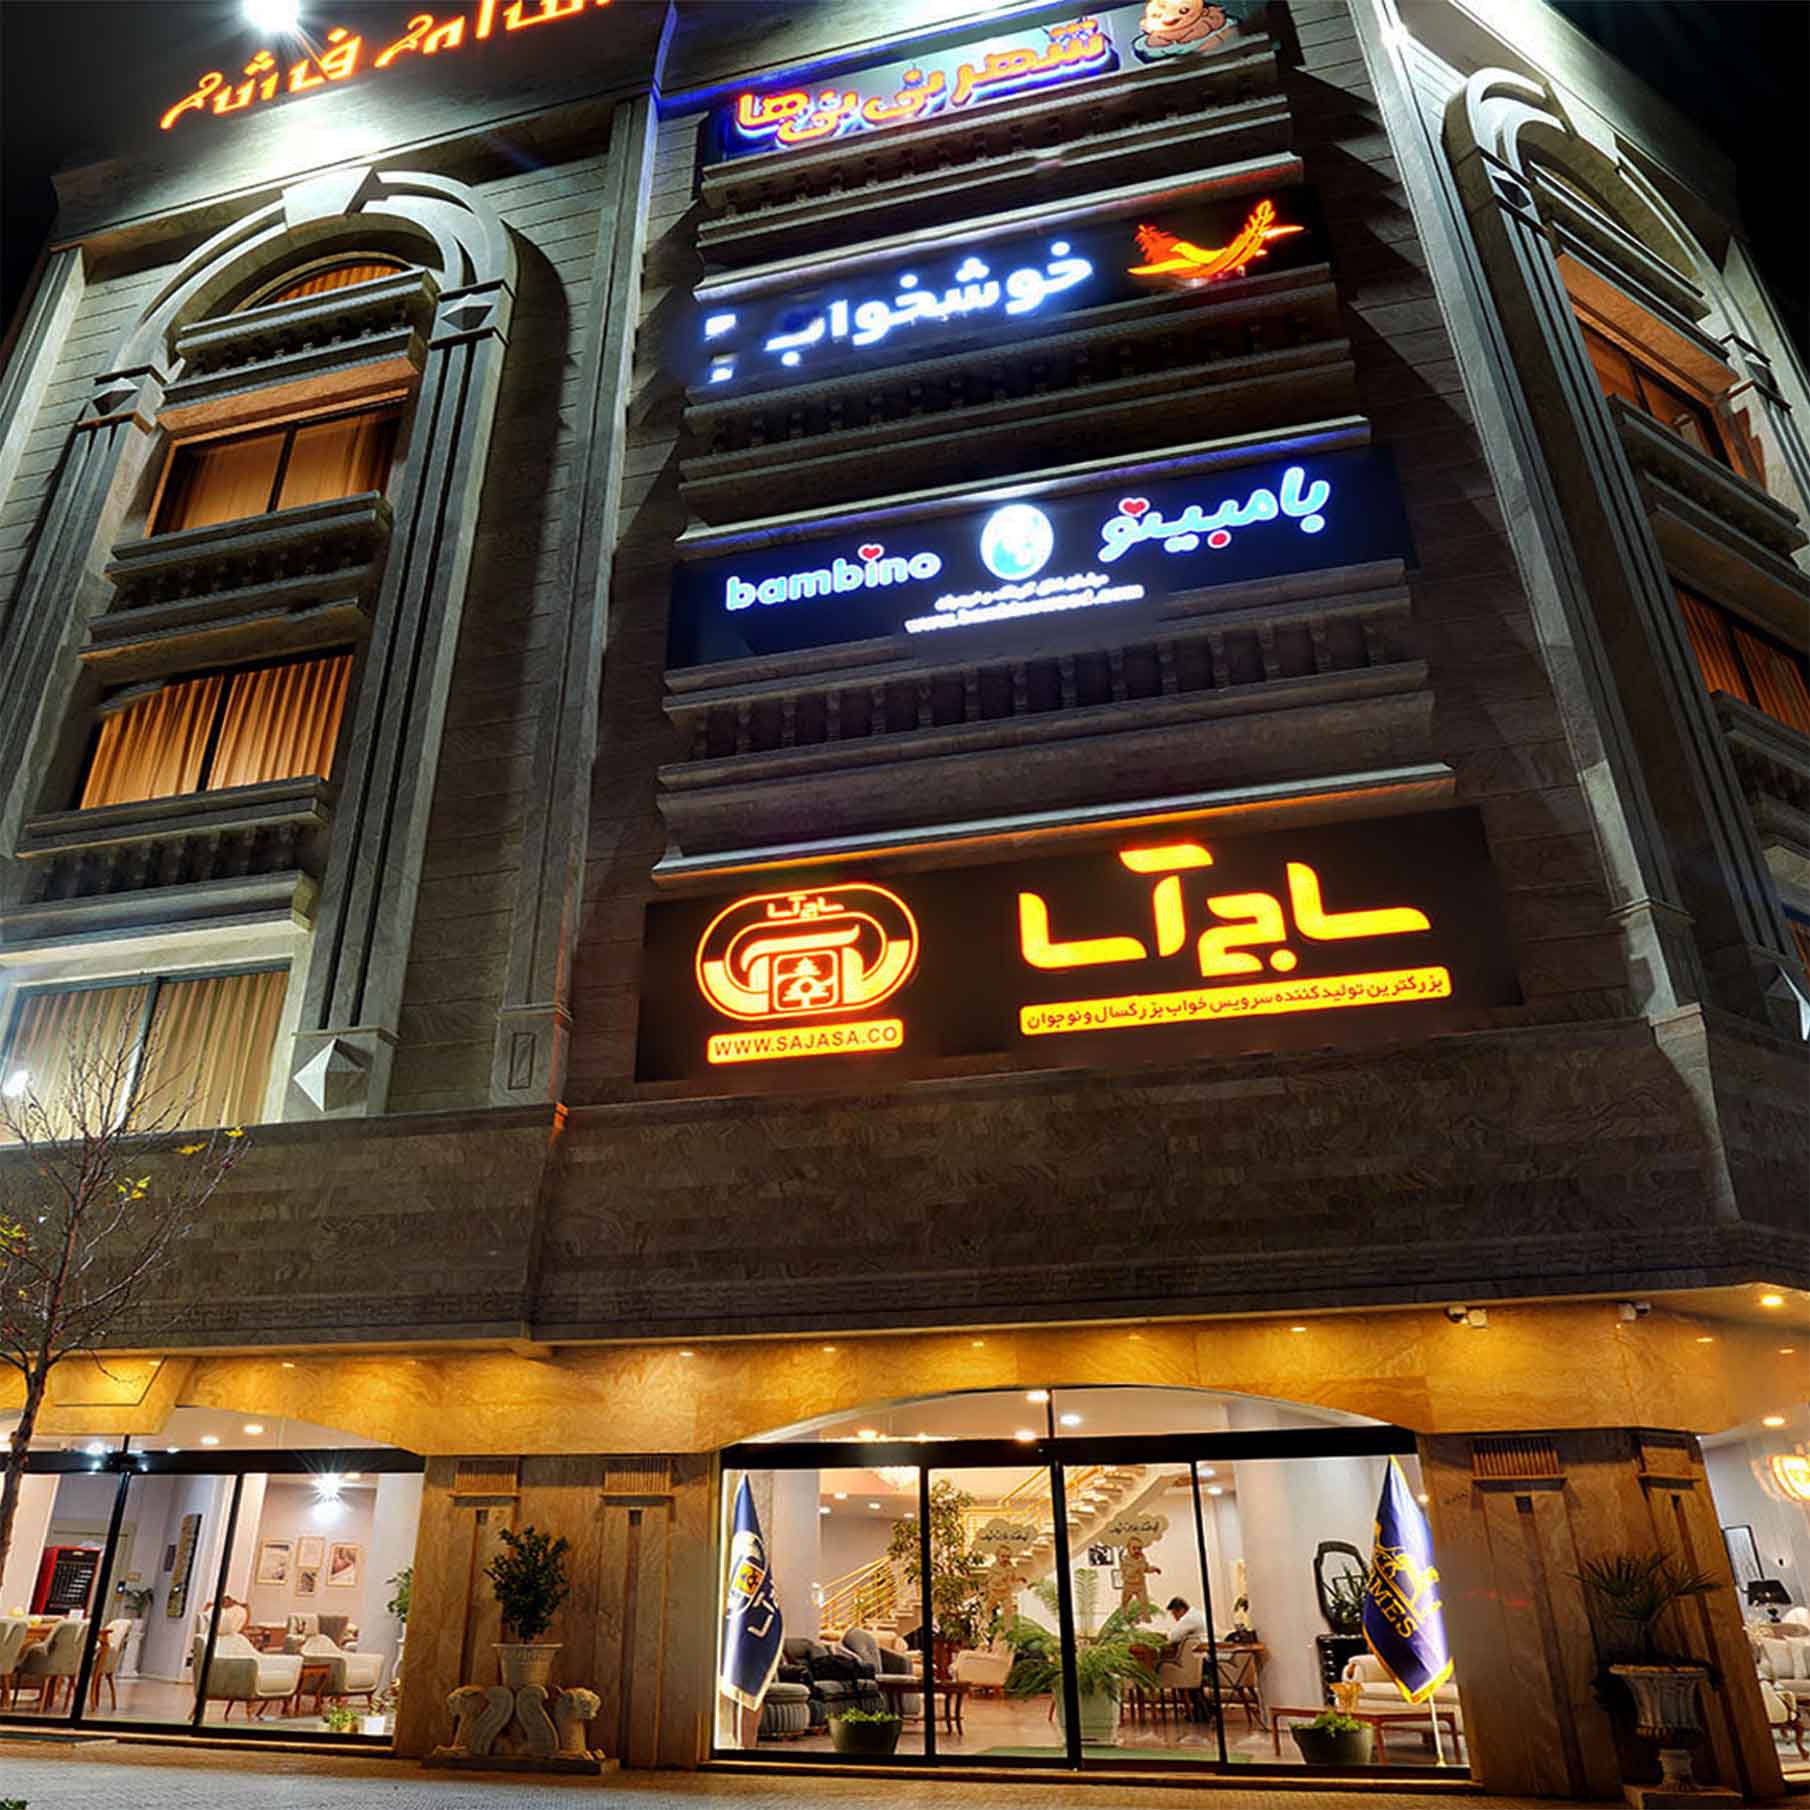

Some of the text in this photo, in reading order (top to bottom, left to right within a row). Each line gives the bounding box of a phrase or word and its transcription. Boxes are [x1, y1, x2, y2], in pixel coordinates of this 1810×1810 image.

[951, 18, 1110, 106] شهر
[763, 240, 1094, 368] خوشخواب
[1099, 466, 1331, 562] بامبینو
[725, 543, 943, 610] bambino
[1026, 1010, 1082, 1029] نوجوان
[1166, 997, 1207, 1015] خواب
[713, 1026, 898, 1057] WWW.SAJASA.CO
